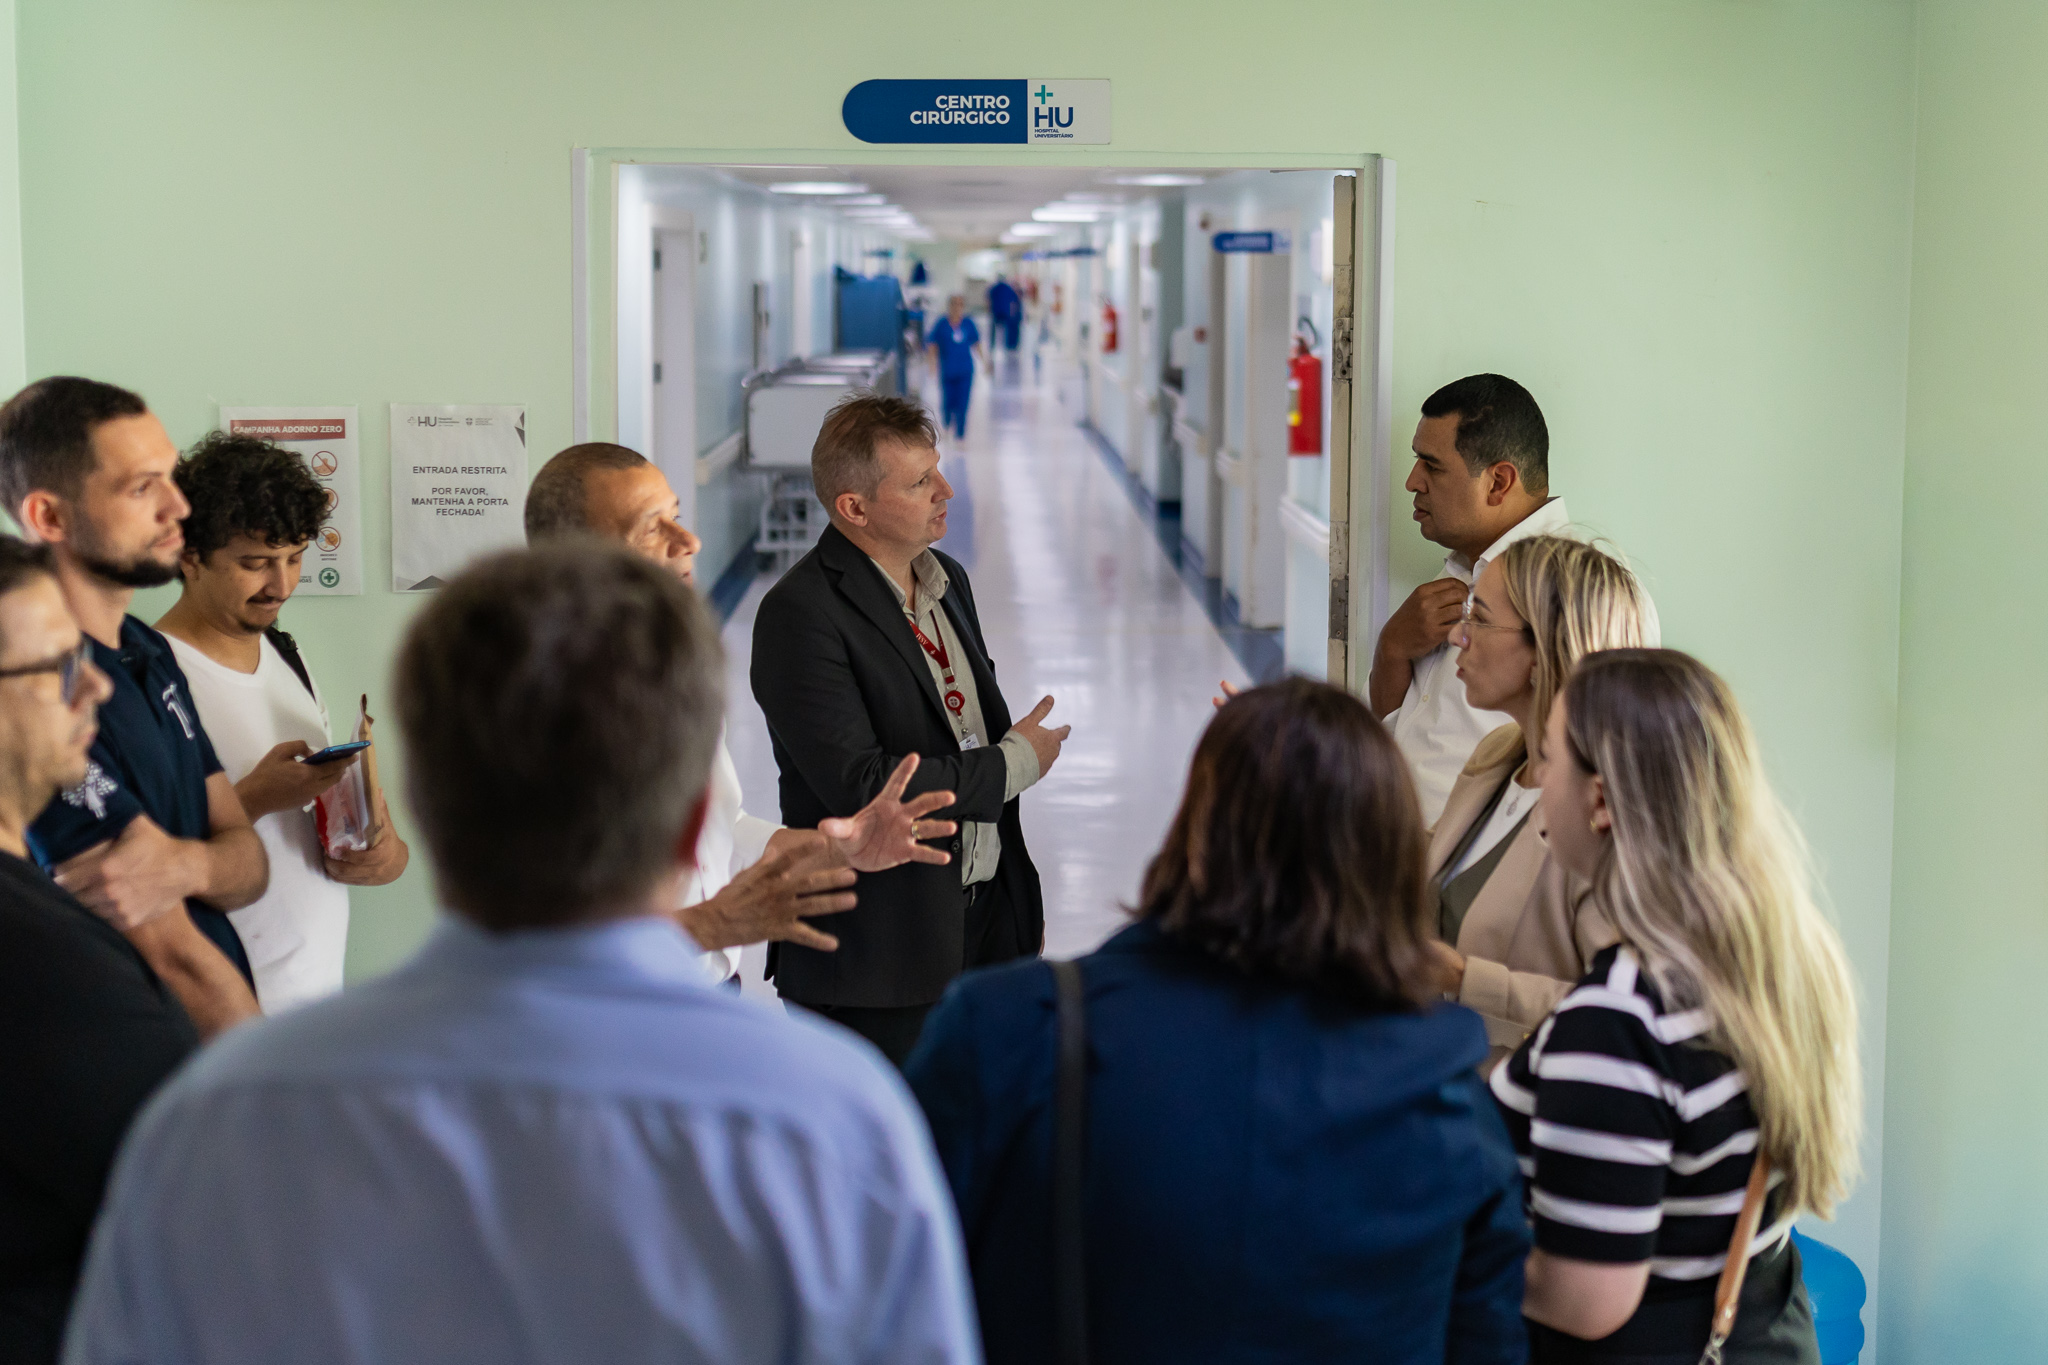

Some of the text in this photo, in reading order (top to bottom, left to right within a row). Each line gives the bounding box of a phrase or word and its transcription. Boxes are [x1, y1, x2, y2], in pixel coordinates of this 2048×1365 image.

[935, 95, 1010, 109] CENTRO
[909, 107, 1010, 125] CIRÚRGICO
[1034, 106, 1074, 128] HU
[417, 416, 437, 427] HU
[282, 425, 318, 433] ADORNO
[320, 425, 342, 433] ZERO
[454, 488, 488, 496] FAVOR,
